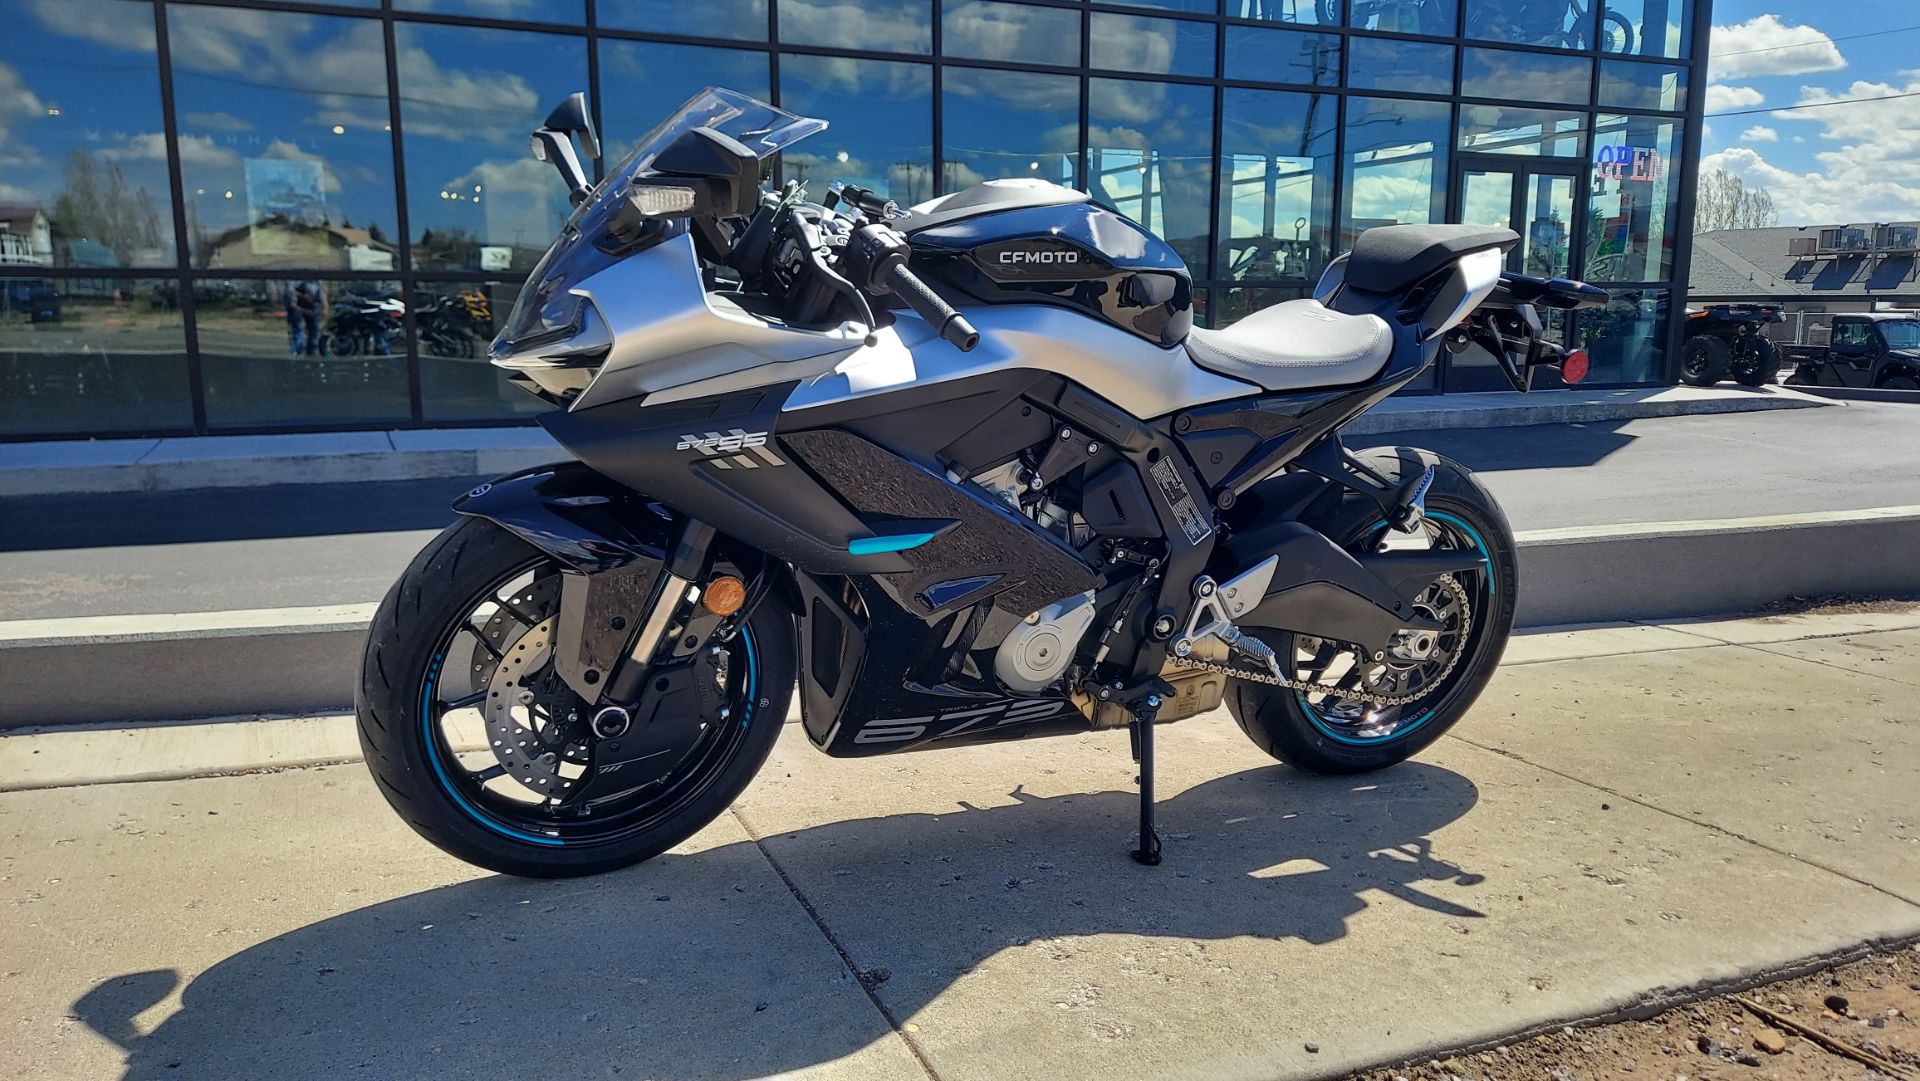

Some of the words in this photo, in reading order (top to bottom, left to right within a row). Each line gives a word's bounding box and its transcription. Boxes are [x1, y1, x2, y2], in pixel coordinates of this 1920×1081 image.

[1597, 144, 1665, 181] OPEN
[999, 251, 1078, 264] CFMOTO
[938, 703, 979, 713] TRIPLE
[854, 698, 1065, 744] 675
